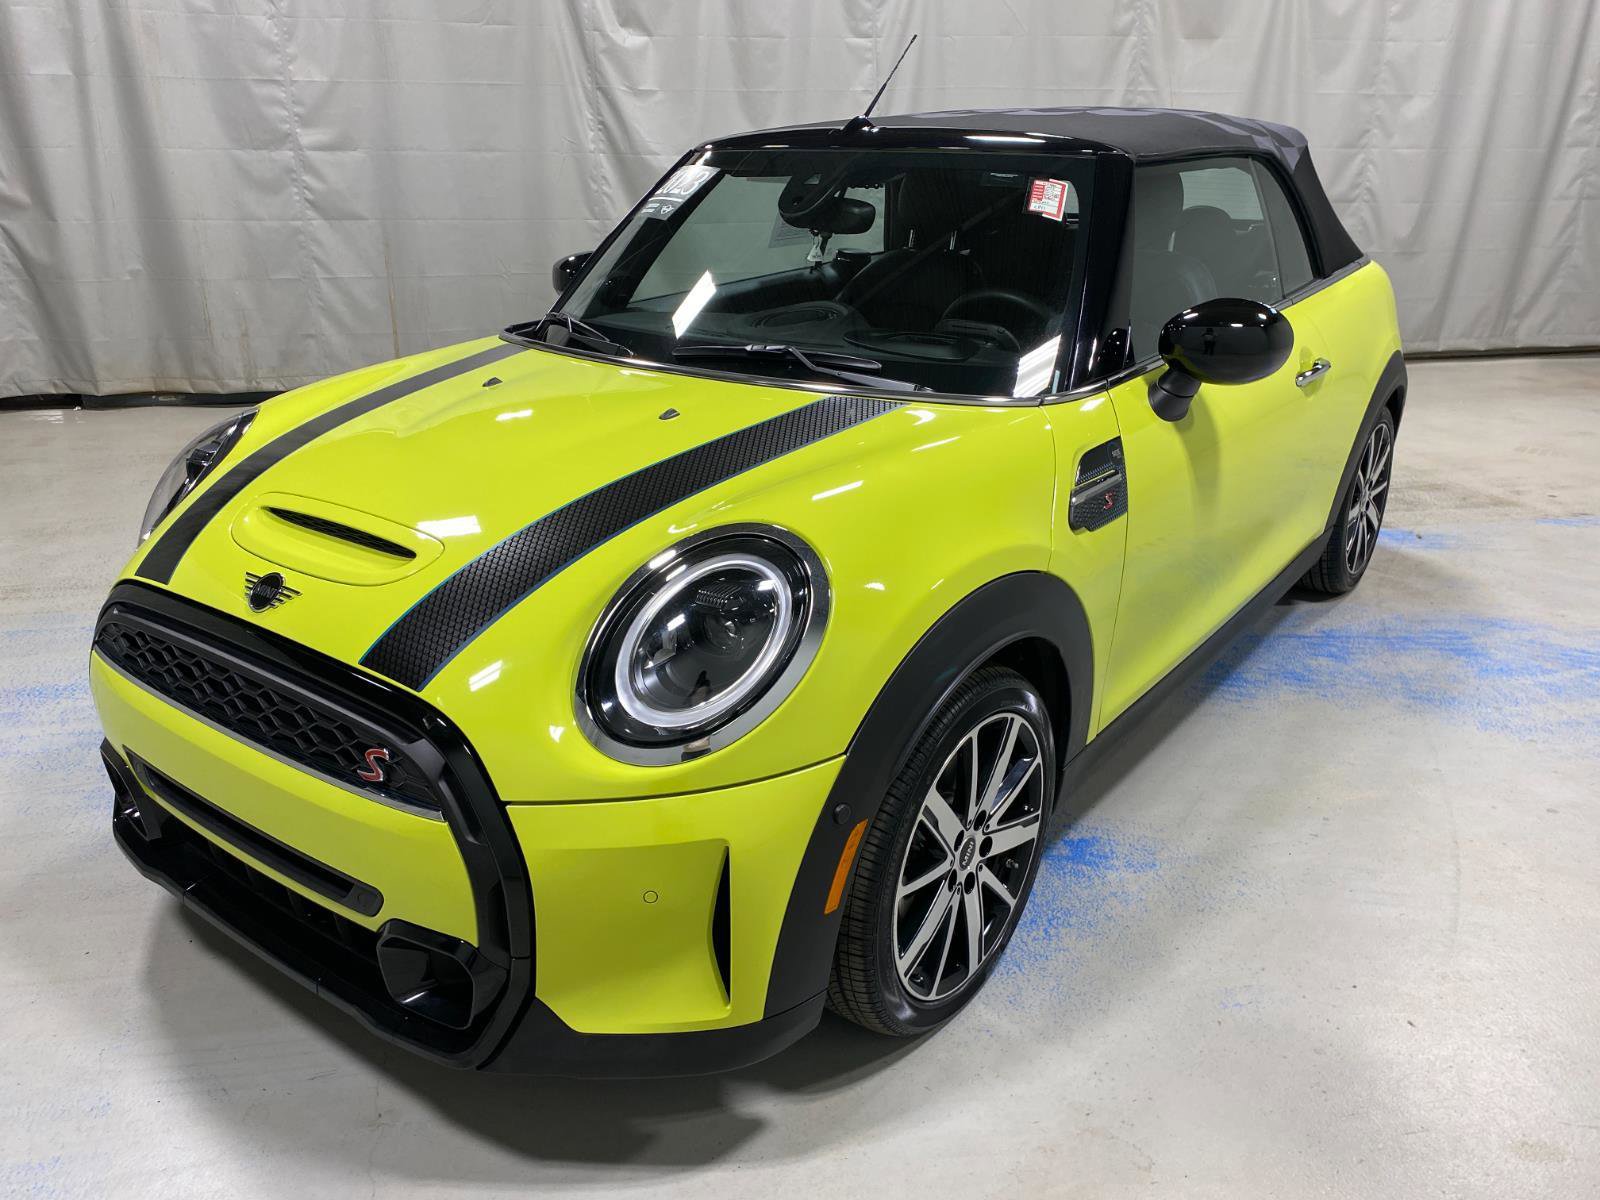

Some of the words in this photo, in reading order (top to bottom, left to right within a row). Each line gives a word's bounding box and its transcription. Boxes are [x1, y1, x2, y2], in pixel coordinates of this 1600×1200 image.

[1103, 491, 1115, 510] S
[357, 748, 389, 781] S
[962, 841, 974, 866] MINI
